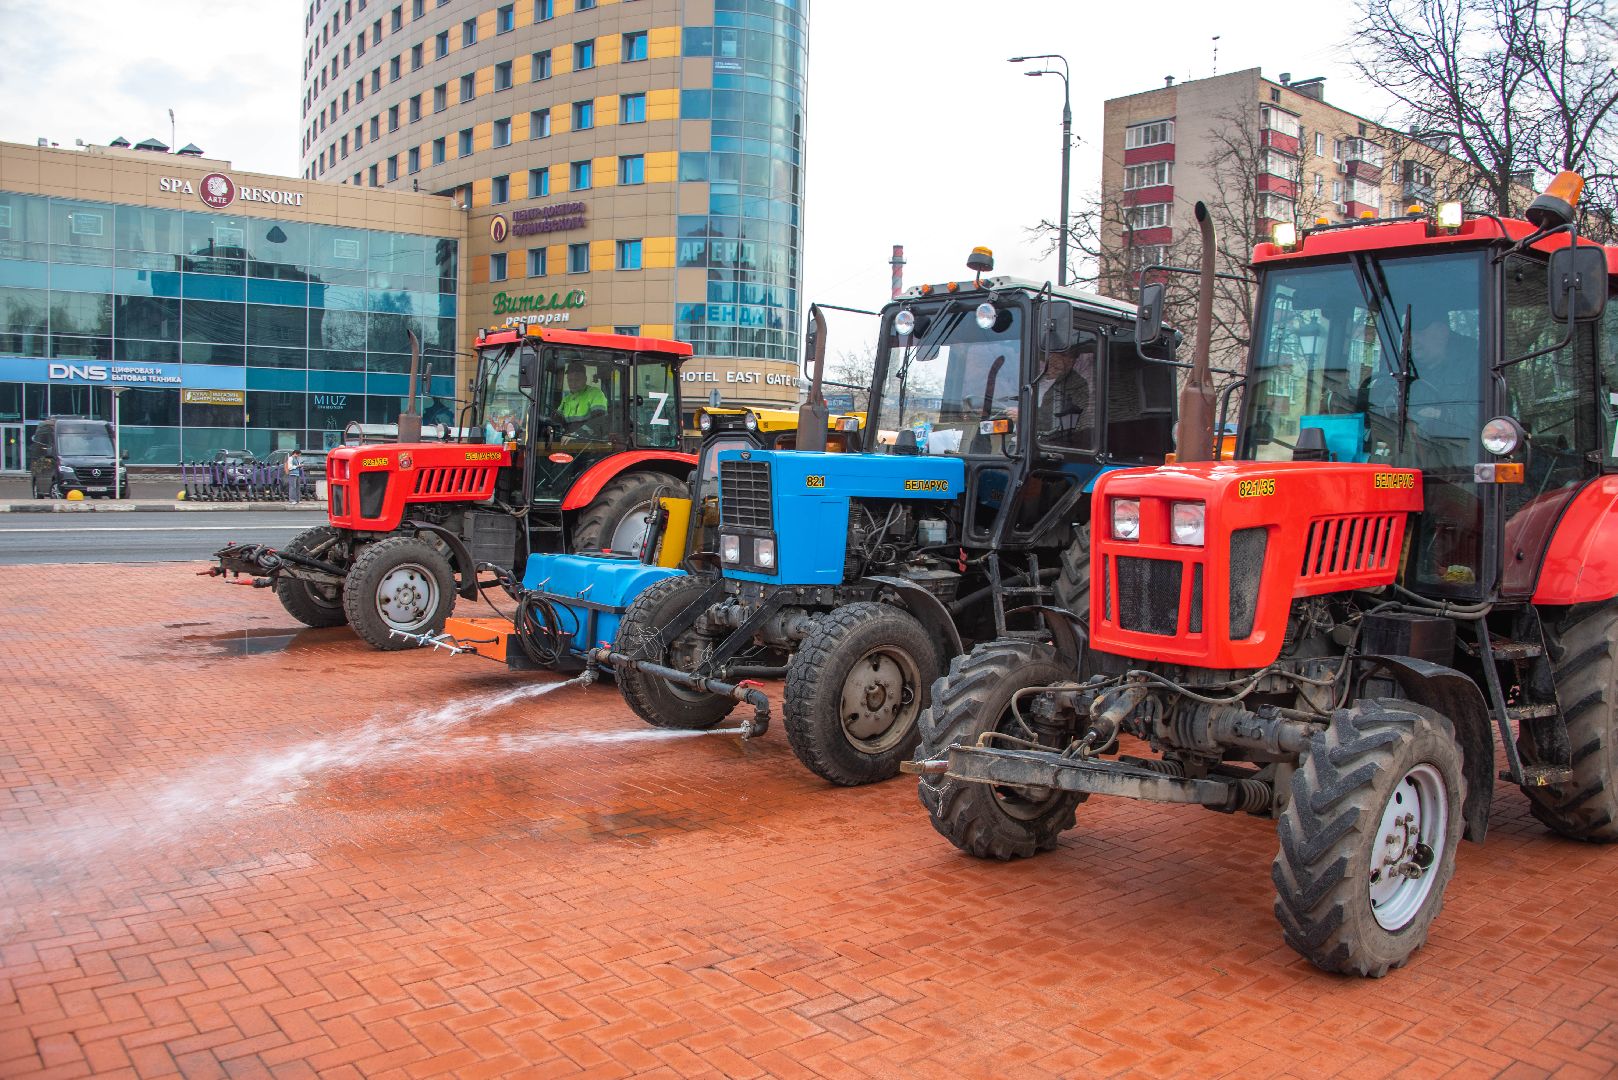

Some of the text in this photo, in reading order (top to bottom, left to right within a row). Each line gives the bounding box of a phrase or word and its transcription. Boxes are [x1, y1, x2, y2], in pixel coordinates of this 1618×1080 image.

[160, 177, 304, 206] SPA RESORT
[207, 196, 228, 204] ARTE
[506, 312, 570, 326] ресторан
[49, 364, 108, 381] DNS
[111, 366, 154, 375] ЦИФРОВАЯ
[111, 374, 182, 383] БЫТОВАЯ ТЕХНИКА
[726, 371, 761, 384] EAST
[766, 373, 790, 386] GATE
[314, 395, 347, 405] MIUZ
[648, 391, 669, 426] Z
[904, 479, 949, 492] БЕЛАРУС
[1374, 472, 1415, 489] БЕЛАРУС
